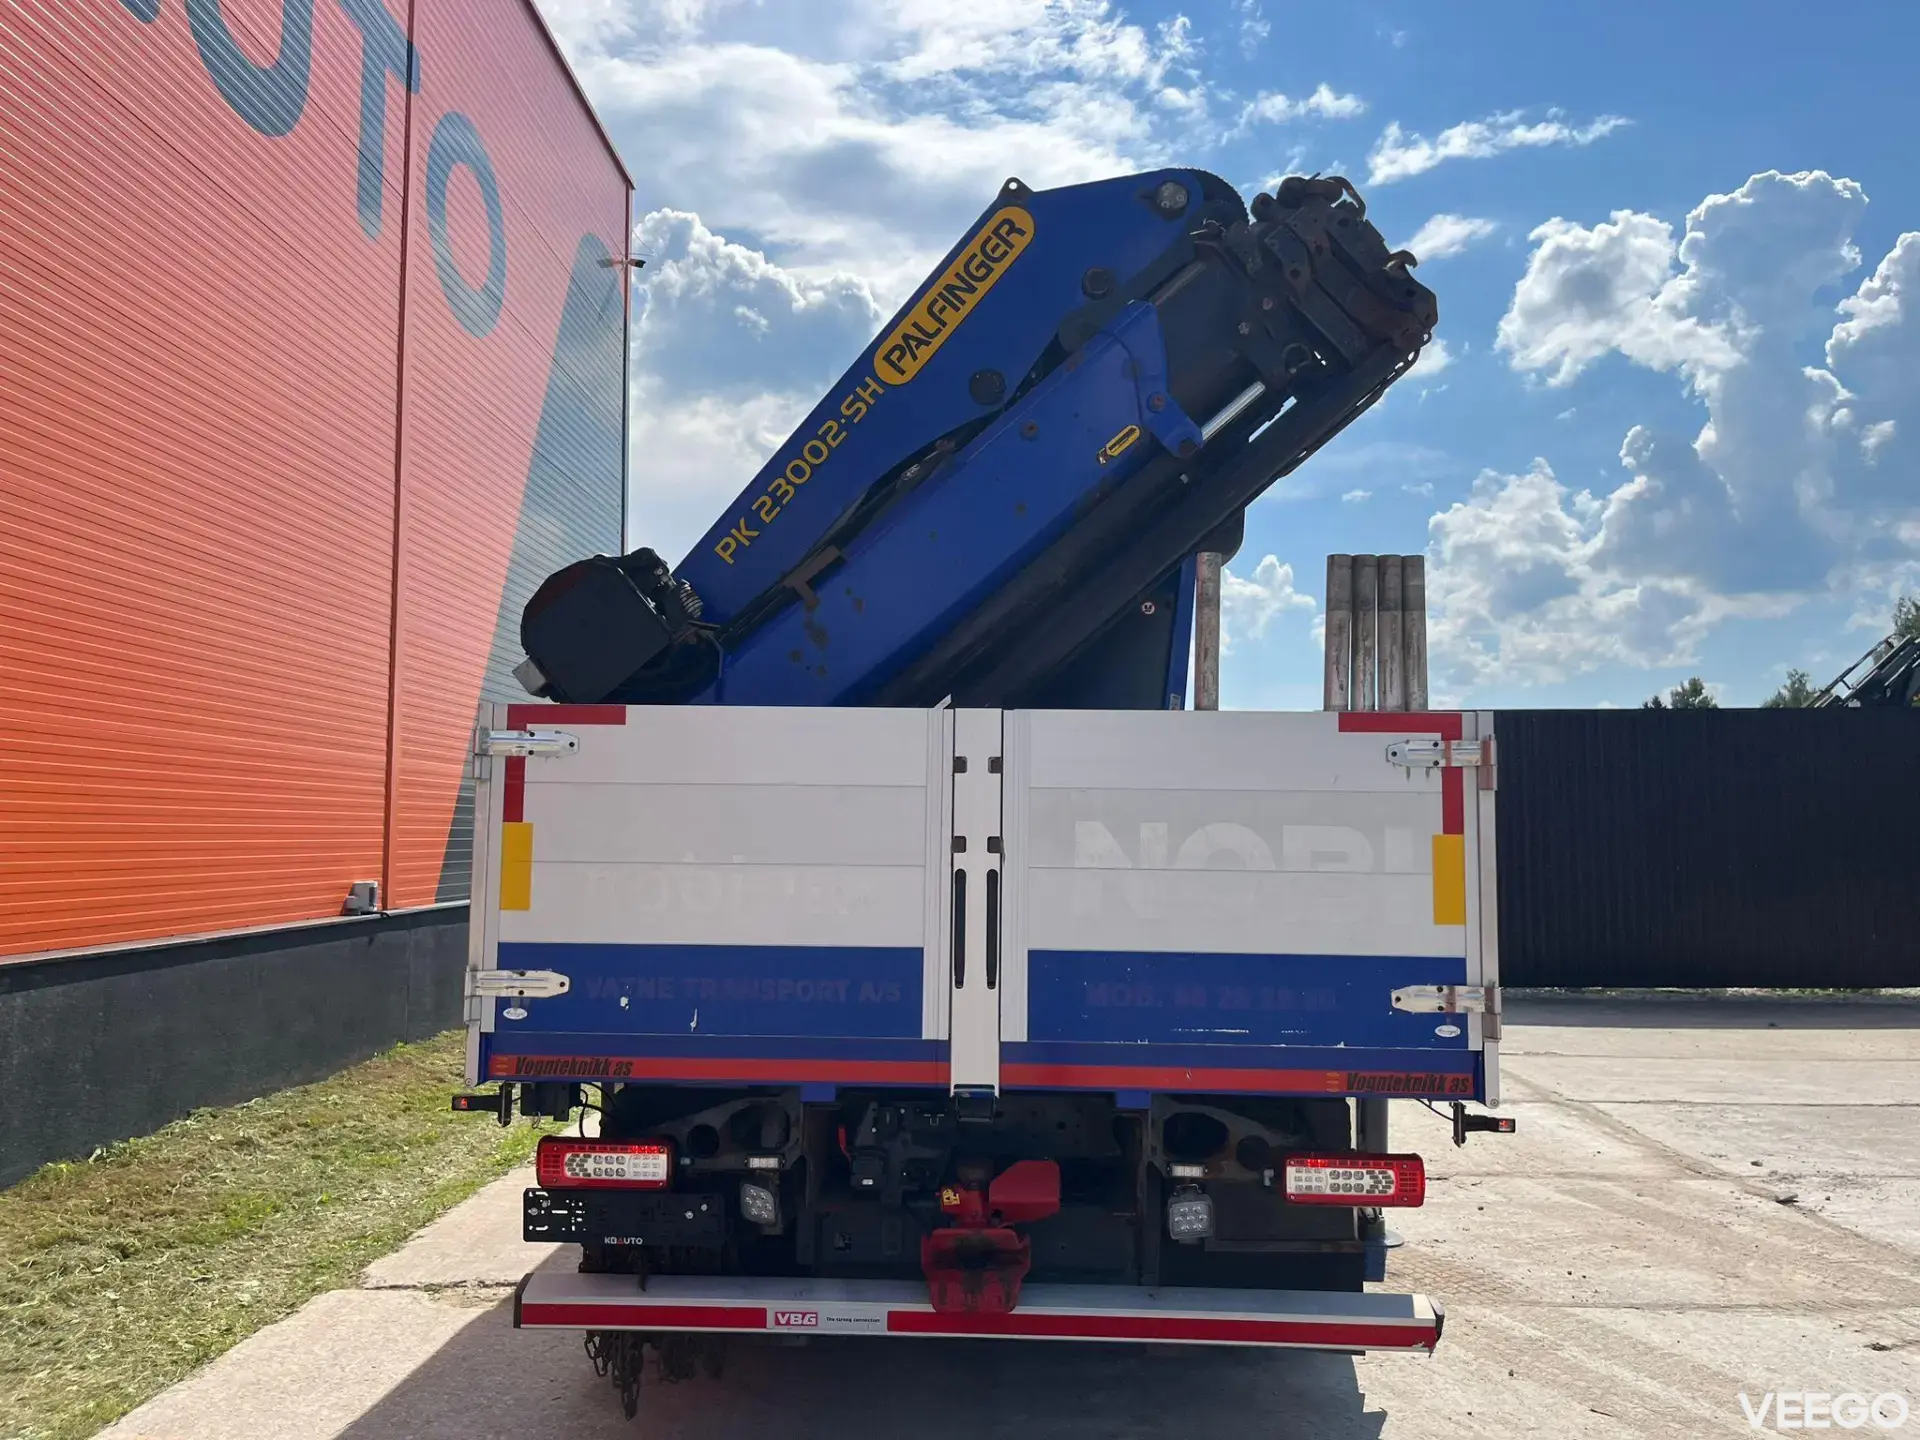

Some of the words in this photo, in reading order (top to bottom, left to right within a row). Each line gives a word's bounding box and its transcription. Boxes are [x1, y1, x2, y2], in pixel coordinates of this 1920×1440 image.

[882, 215, 1028, 376] PALFINGER
[714, 517, 761, 564] PK
[515, 1056, 612, 1077] Vognteknikk
[613, 1060, 633, 1077] as
[1346, 1072, 1448, 1093] Vognteknikk
[1450, 1076, 1470, 1093] as
[776, 1312, 817, 1325] VBG
